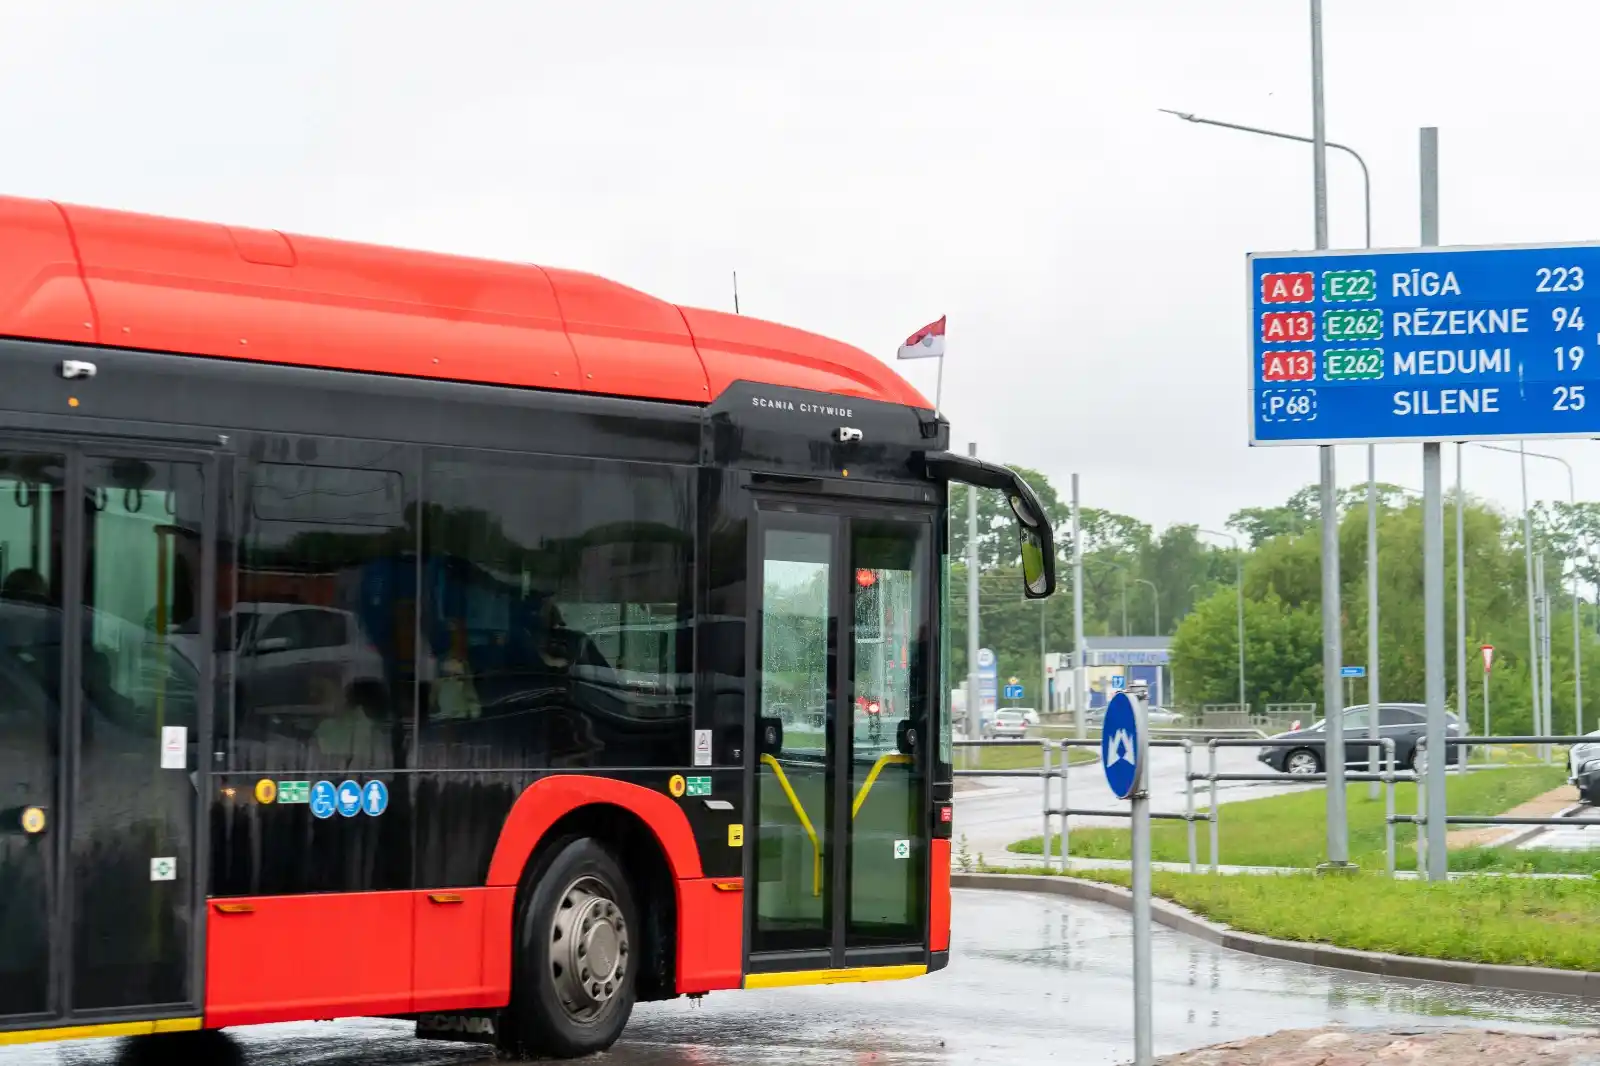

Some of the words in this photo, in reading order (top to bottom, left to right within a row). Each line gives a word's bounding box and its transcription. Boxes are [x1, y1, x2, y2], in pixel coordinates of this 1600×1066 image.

[1330, 276, 1370, 296] E22
[1392, 268, 1462, 297] RĪGA
[1536, 266, 1584, 293] 223
[1267, 317, 1309, 337] A13
[1328, 316, 1379, 335] E262
[1392, 307, 1529, 337] RĒZEKNE
[1551, 306, 1585, 332] 94
[1267, 356, 1309, 376] A13
[1328, 355, 1380, 375] E262
[1392, 348, 1511, 376] MEDUMI
[1553, 345, 1585, 371] 19
[752, 398, 794, 411] SCANIA
[800, 404, 853, 418] CITYWIDE
[1270, 395, 1310, 415] P68
[1392, 387, 1500, 416] SILENE
[1552, 385, 1586, 411] 25
